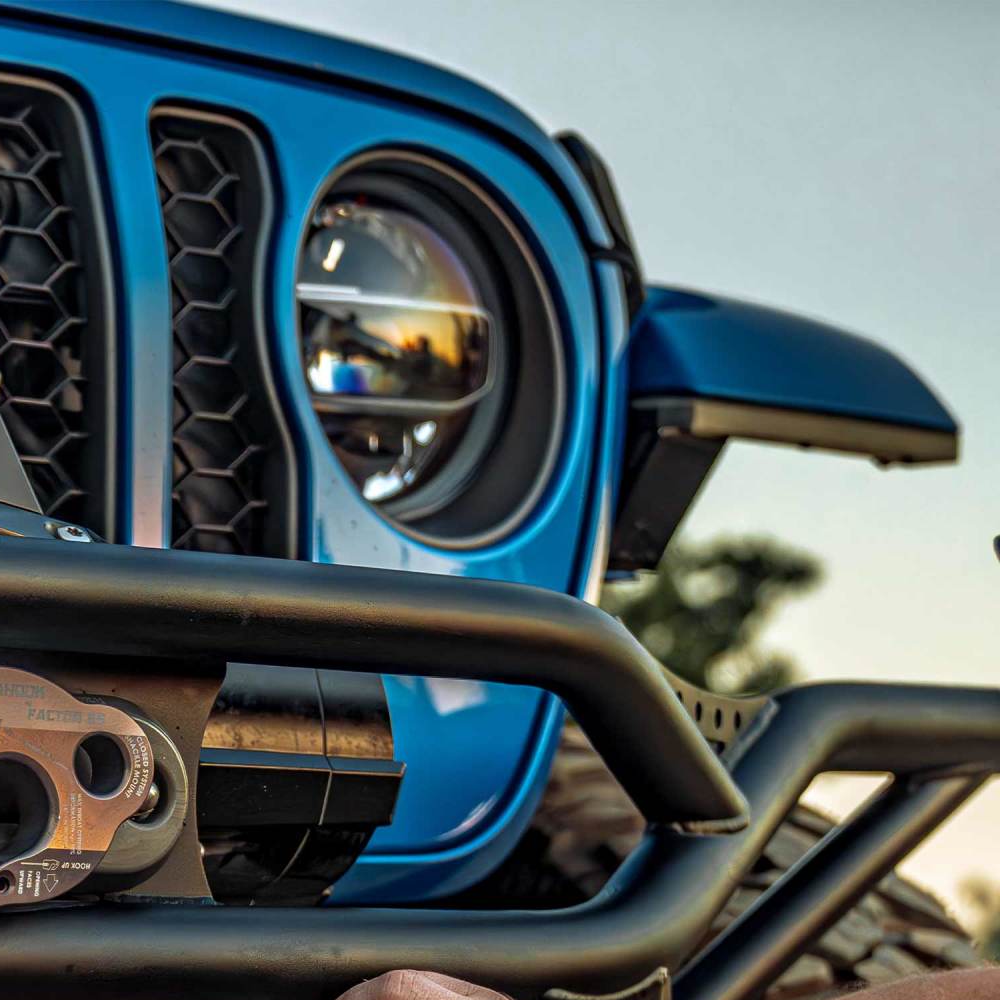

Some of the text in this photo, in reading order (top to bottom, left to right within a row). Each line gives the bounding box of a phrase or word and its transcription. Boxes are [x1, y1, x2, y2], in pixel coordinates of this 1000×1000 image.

[135, 736, 149, 797] CLOSED SYSTEM
[124, 769, 141, 799] MOUNT
[60, 861, 91, 870] HOOK UP
